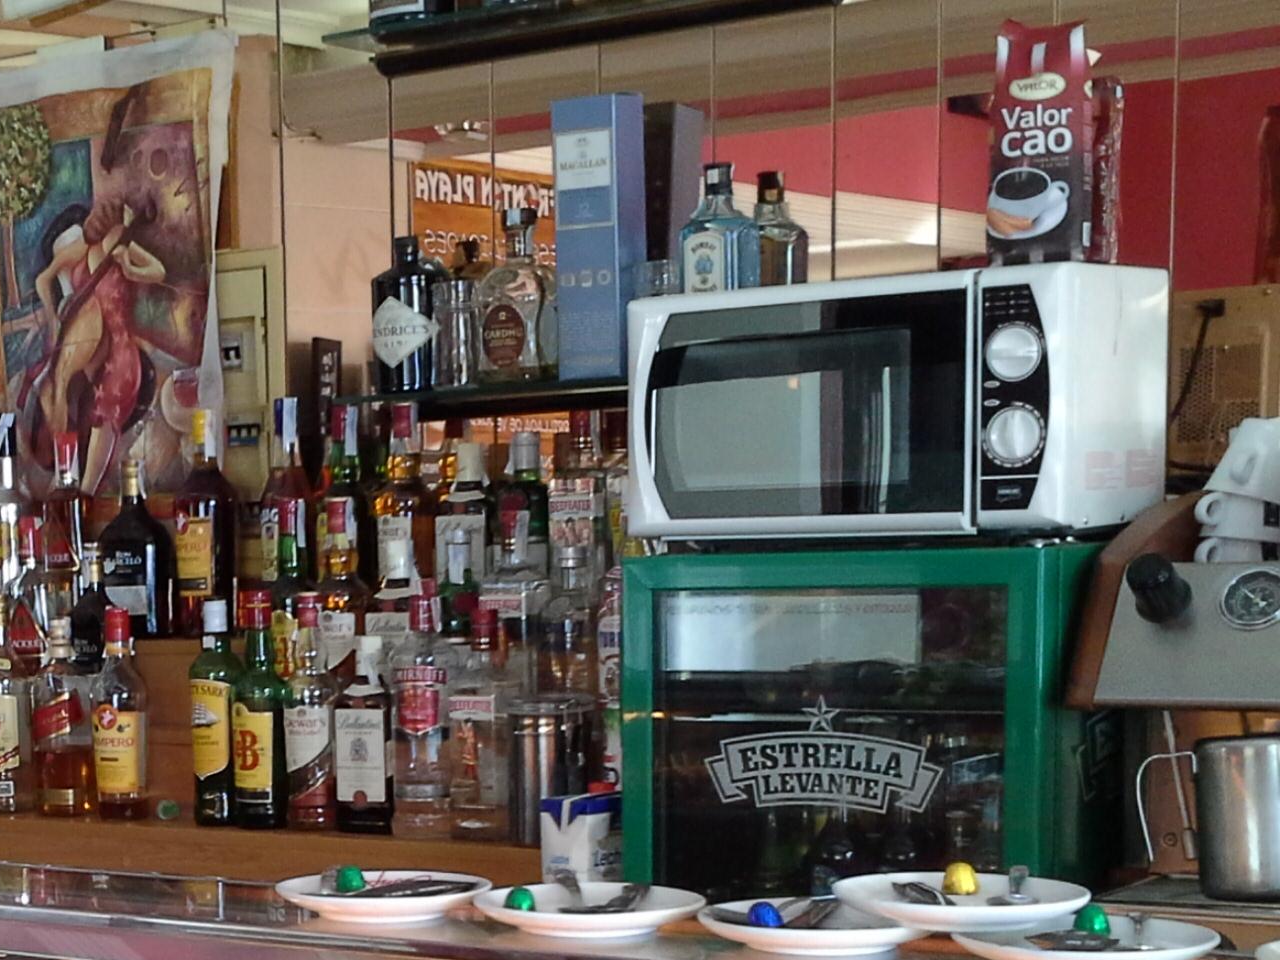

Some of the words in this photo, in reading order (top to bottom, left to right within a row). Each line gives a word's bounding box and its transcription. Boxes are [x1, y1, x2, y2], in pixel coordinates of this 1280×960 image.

[1001, 104, 1073, 129] Valor
[1001, 127, 1073, 157] cao
[738, 742, 903, 779] ESTRELLA
[762, 772, 879, 800] LEVANTE
